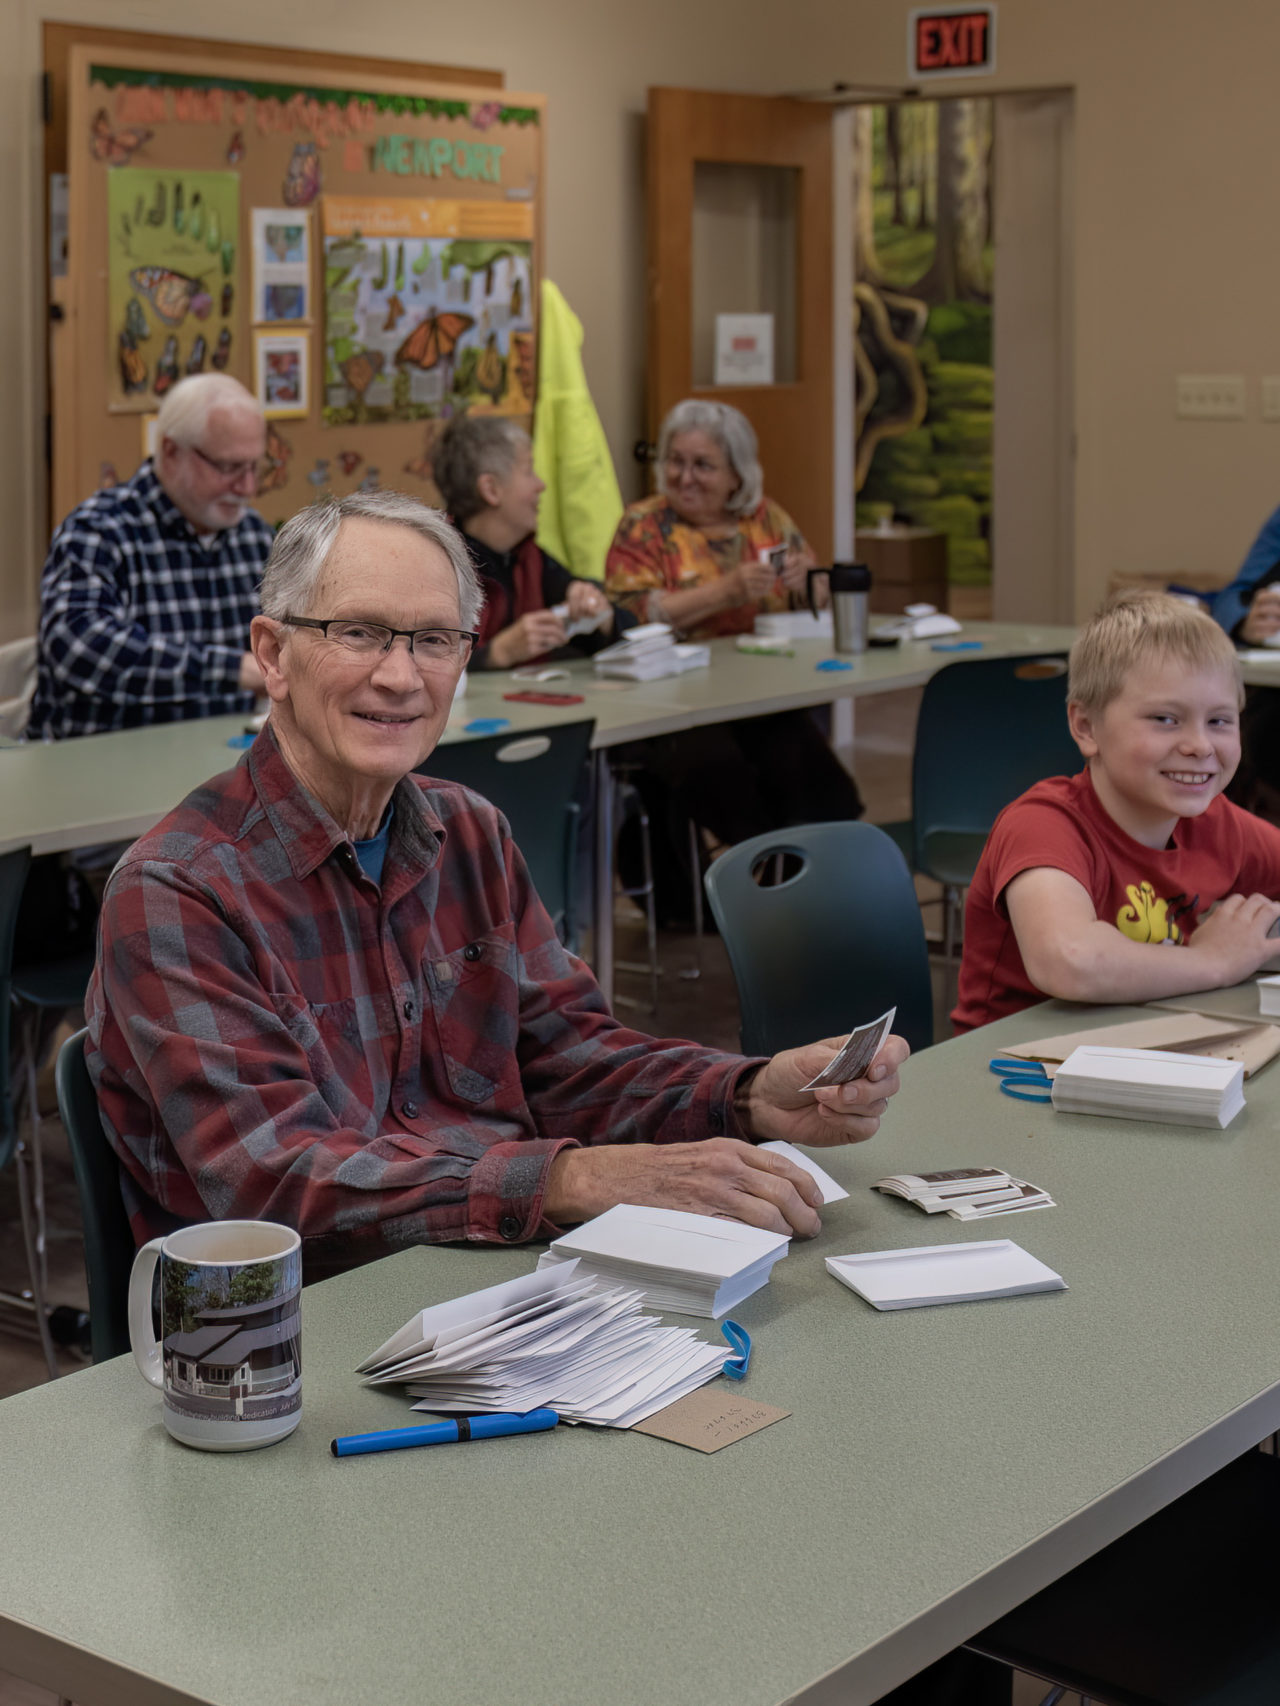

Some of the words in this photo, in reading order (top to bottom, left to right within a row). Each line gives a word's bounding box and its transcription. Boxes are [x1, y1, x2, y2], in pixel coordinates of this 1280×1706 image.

[919, 15, 988, 68] EXIT
[375, 133, 506, 184] NEWPORT
[241, 1407, 278, 1420] dedication
